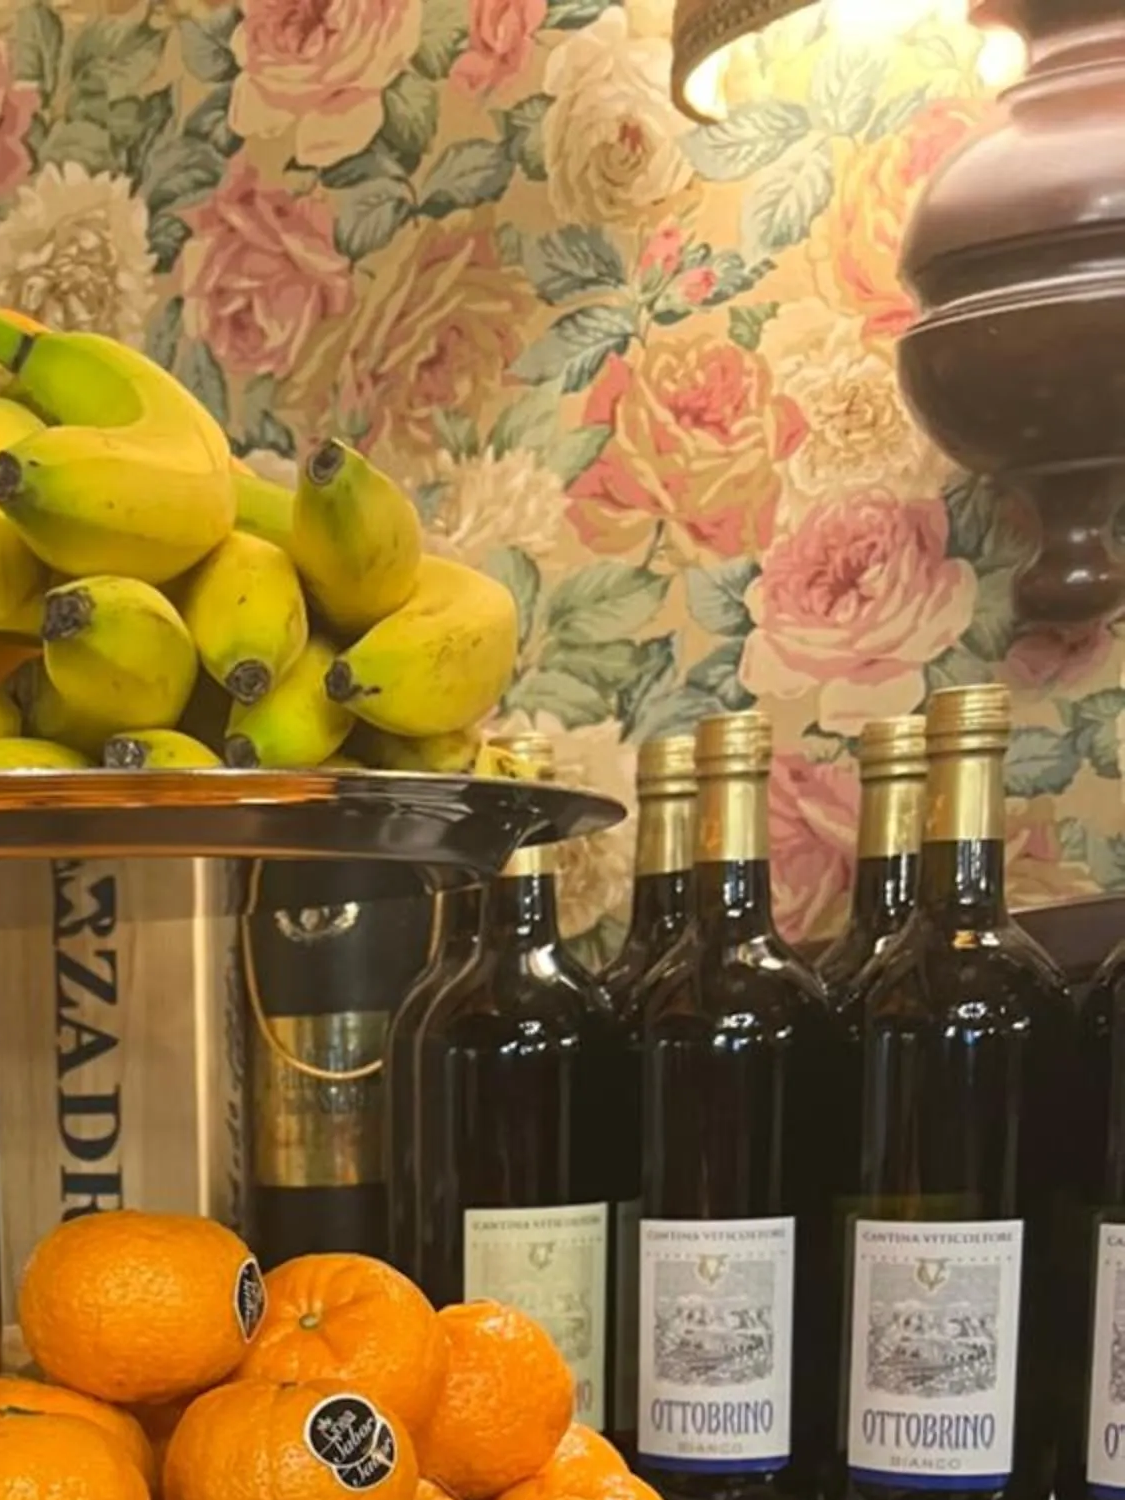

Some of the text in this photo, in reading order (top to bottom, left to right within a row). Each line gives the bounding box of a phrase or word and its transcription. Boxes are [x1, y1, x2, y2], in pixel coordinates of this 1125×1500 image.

[650, 1398, 774, 1435] OTTOBRINO
[861, 1408, 996, 1450] OTTOBRINO
[889, 1455, 962, 1471] BIANCO
